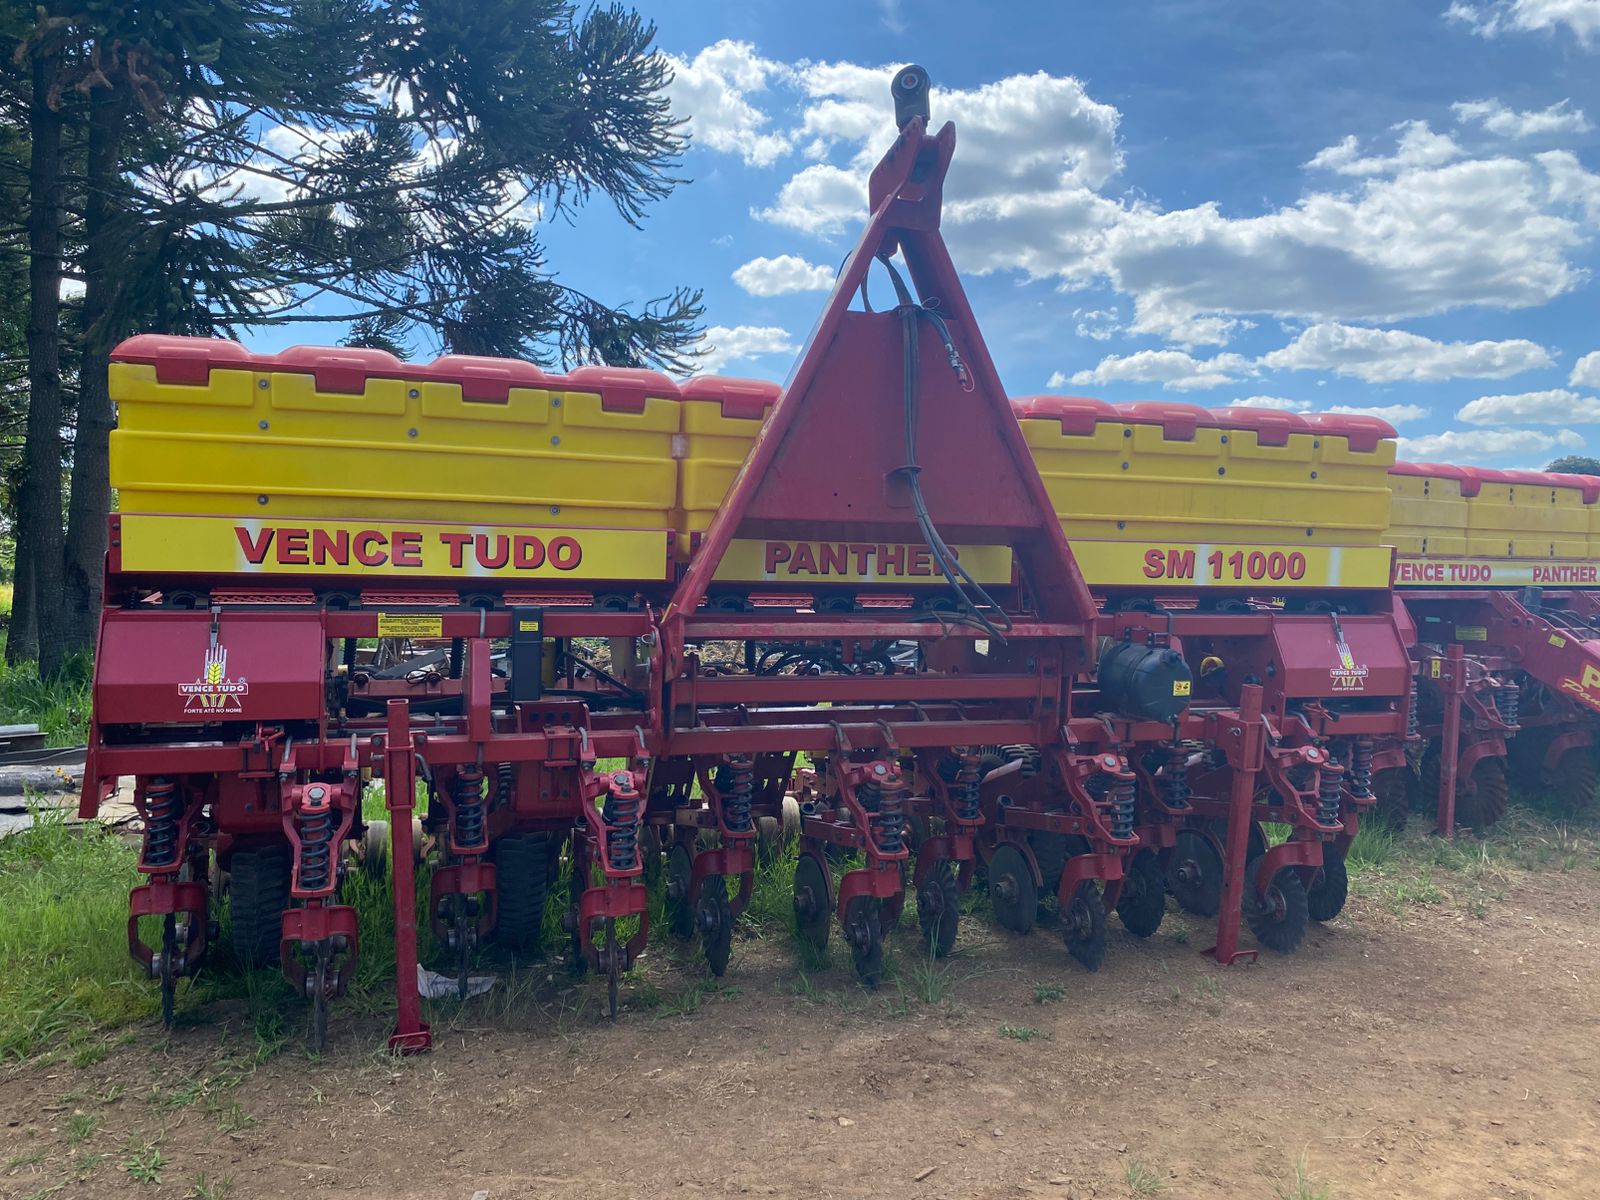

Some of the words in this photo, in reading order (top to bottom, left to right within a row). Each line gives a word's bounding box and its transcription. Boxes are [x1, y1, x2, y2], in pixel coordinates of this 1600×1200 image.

[234, 526, 423, 566] VENCE
[440, 532, 582, 570] TUDO
[765, 541, 960, 577] PANTHER
[1142, 548, 1196, 580] SM
[1207, 550, 1307, 581] 11000
[1448, 563, 1492, 583] TUDO
[1532, 566, 1598, 583] PANTHER
